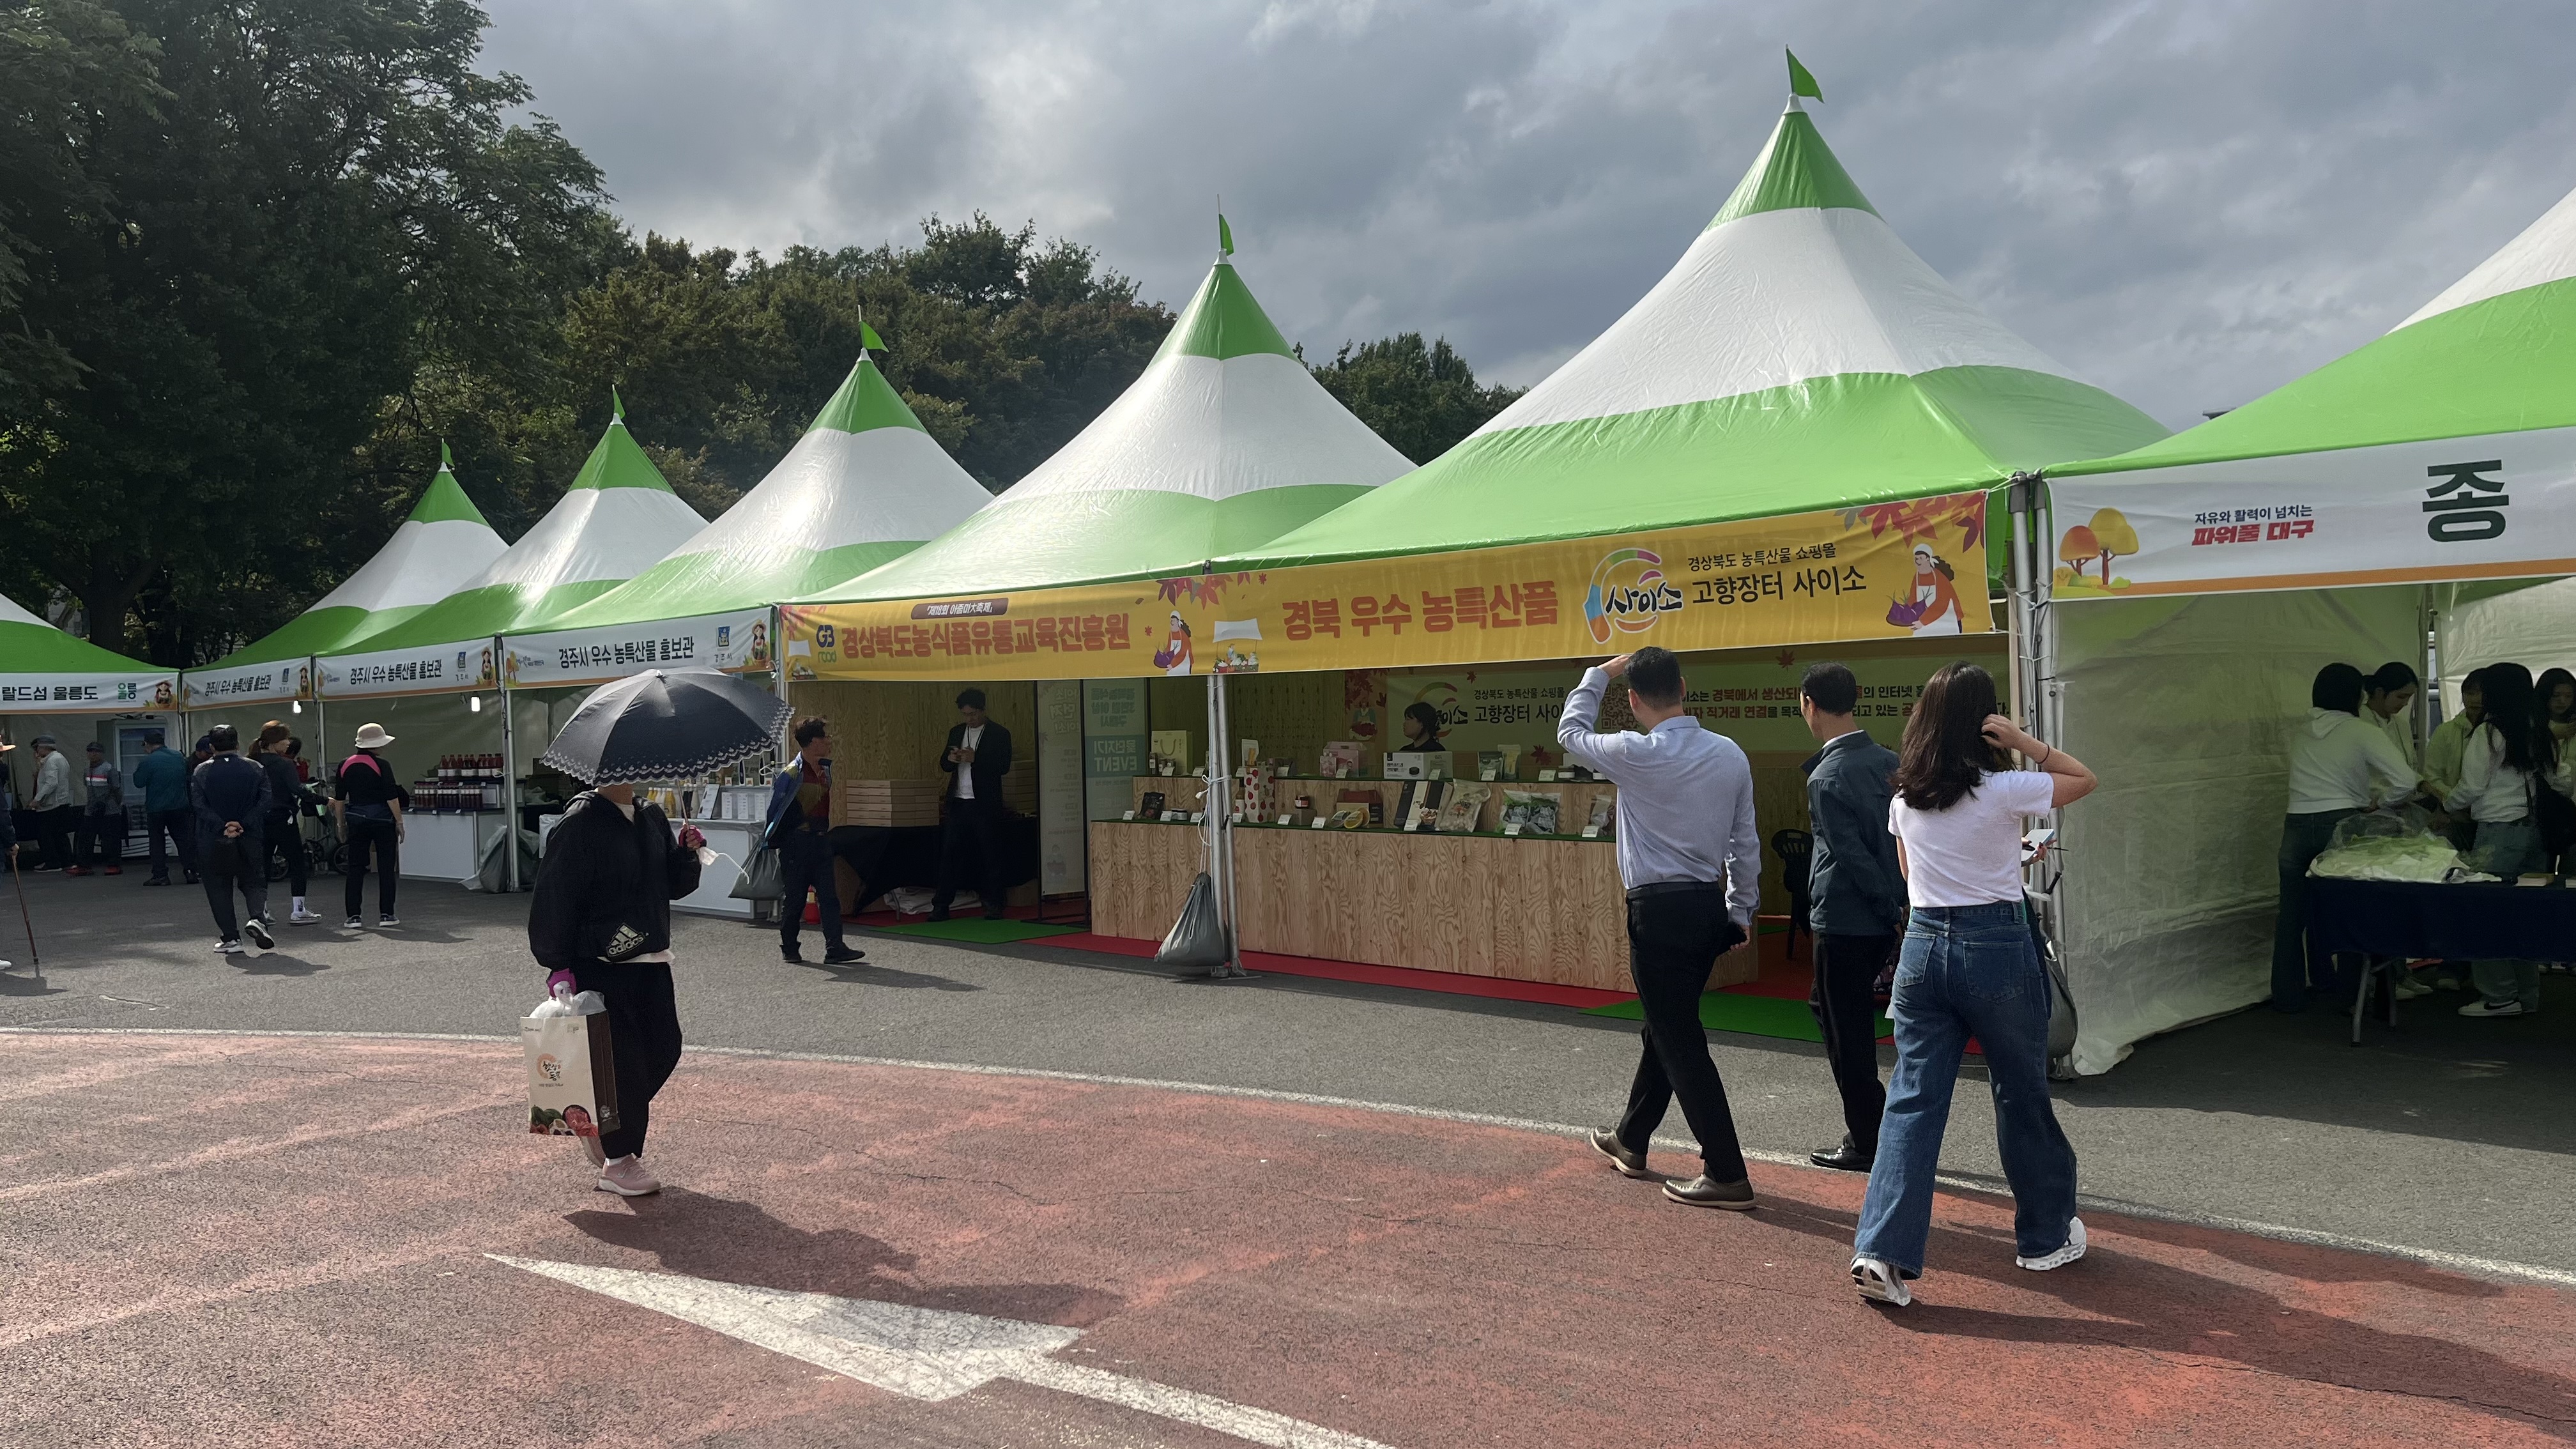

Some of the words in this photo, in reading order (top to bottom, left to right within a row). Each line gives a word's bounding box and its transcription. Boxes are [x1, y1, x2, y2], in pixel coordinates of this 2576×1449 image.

[2422, 459, 2510, 542] 종
[2195, 510, 2231, 525] 자유와
[2234, 507, 2271, 523] 활력이
[2275, 505, 2313, 519] 넘치는
[2191, 524, 2261, 546] 파워풀
[2266, 520, 2315, 540] 대구
[1687, 553, 1738, 572] 경상북도
[1741, 548, 1791, 567] 농특산물
[1795, 542, 1837, 561] 쇼핑몰
[1692, 571, 1784, 605] 고향장터
[1793, 565, 1867, 597] 사이소
[1605, 581, 1683, 614] 사이소
[1282, 598, 1341, 641] 경북
[1351, 594, 1412, 637] 우수
[1422, 581, 1558, 633] 농특산품
[842, 613, 1131, 659] 경상북도농식품유통교육진흥원
[559, 646, 589, 668] 경주시
[591, 645, 611, 666] 우수
[614, 640, 656, 664] 농특산물
[660, 636, 694, 661] 홍보관
[350, 666, 371, 684] 경주시
[372, 665, 386, 683] 우수
[388, 662, 417, 682] 농특산물
[419, 659, 441, 679] 홍보관
[54, 686, 98, 701] 울릉도
[118, 682, 137, 700] 울릉
[205, 680, 221, 696] 경주시
[220, 679, 231, 694] 우수
[231, 677, 254, 693] 농특산물
[254, 675, 272, 691] 홍보관
[1475, 689, 1503, 700] 경상북도
[1506, 688, 1538, 699] 농특산물
[1541, 687, 1565, 698] 쇼핑몰
[1712, 688, 1758, 702] 경북에서
[1762, 687, 1802, 702] 생산되
[1878, 685, 1912, 698] 인터넷
[1438, 705, 1468, 724] 이소
[1475, 704, 1529, 723] 고향장터
[1706, 705, 1740, 718] 직거래
[1745, 705, 1777, 718] 연결을
[1876, 704, 1897, 716] 있는
[609, 935, 644, 954] adidas
